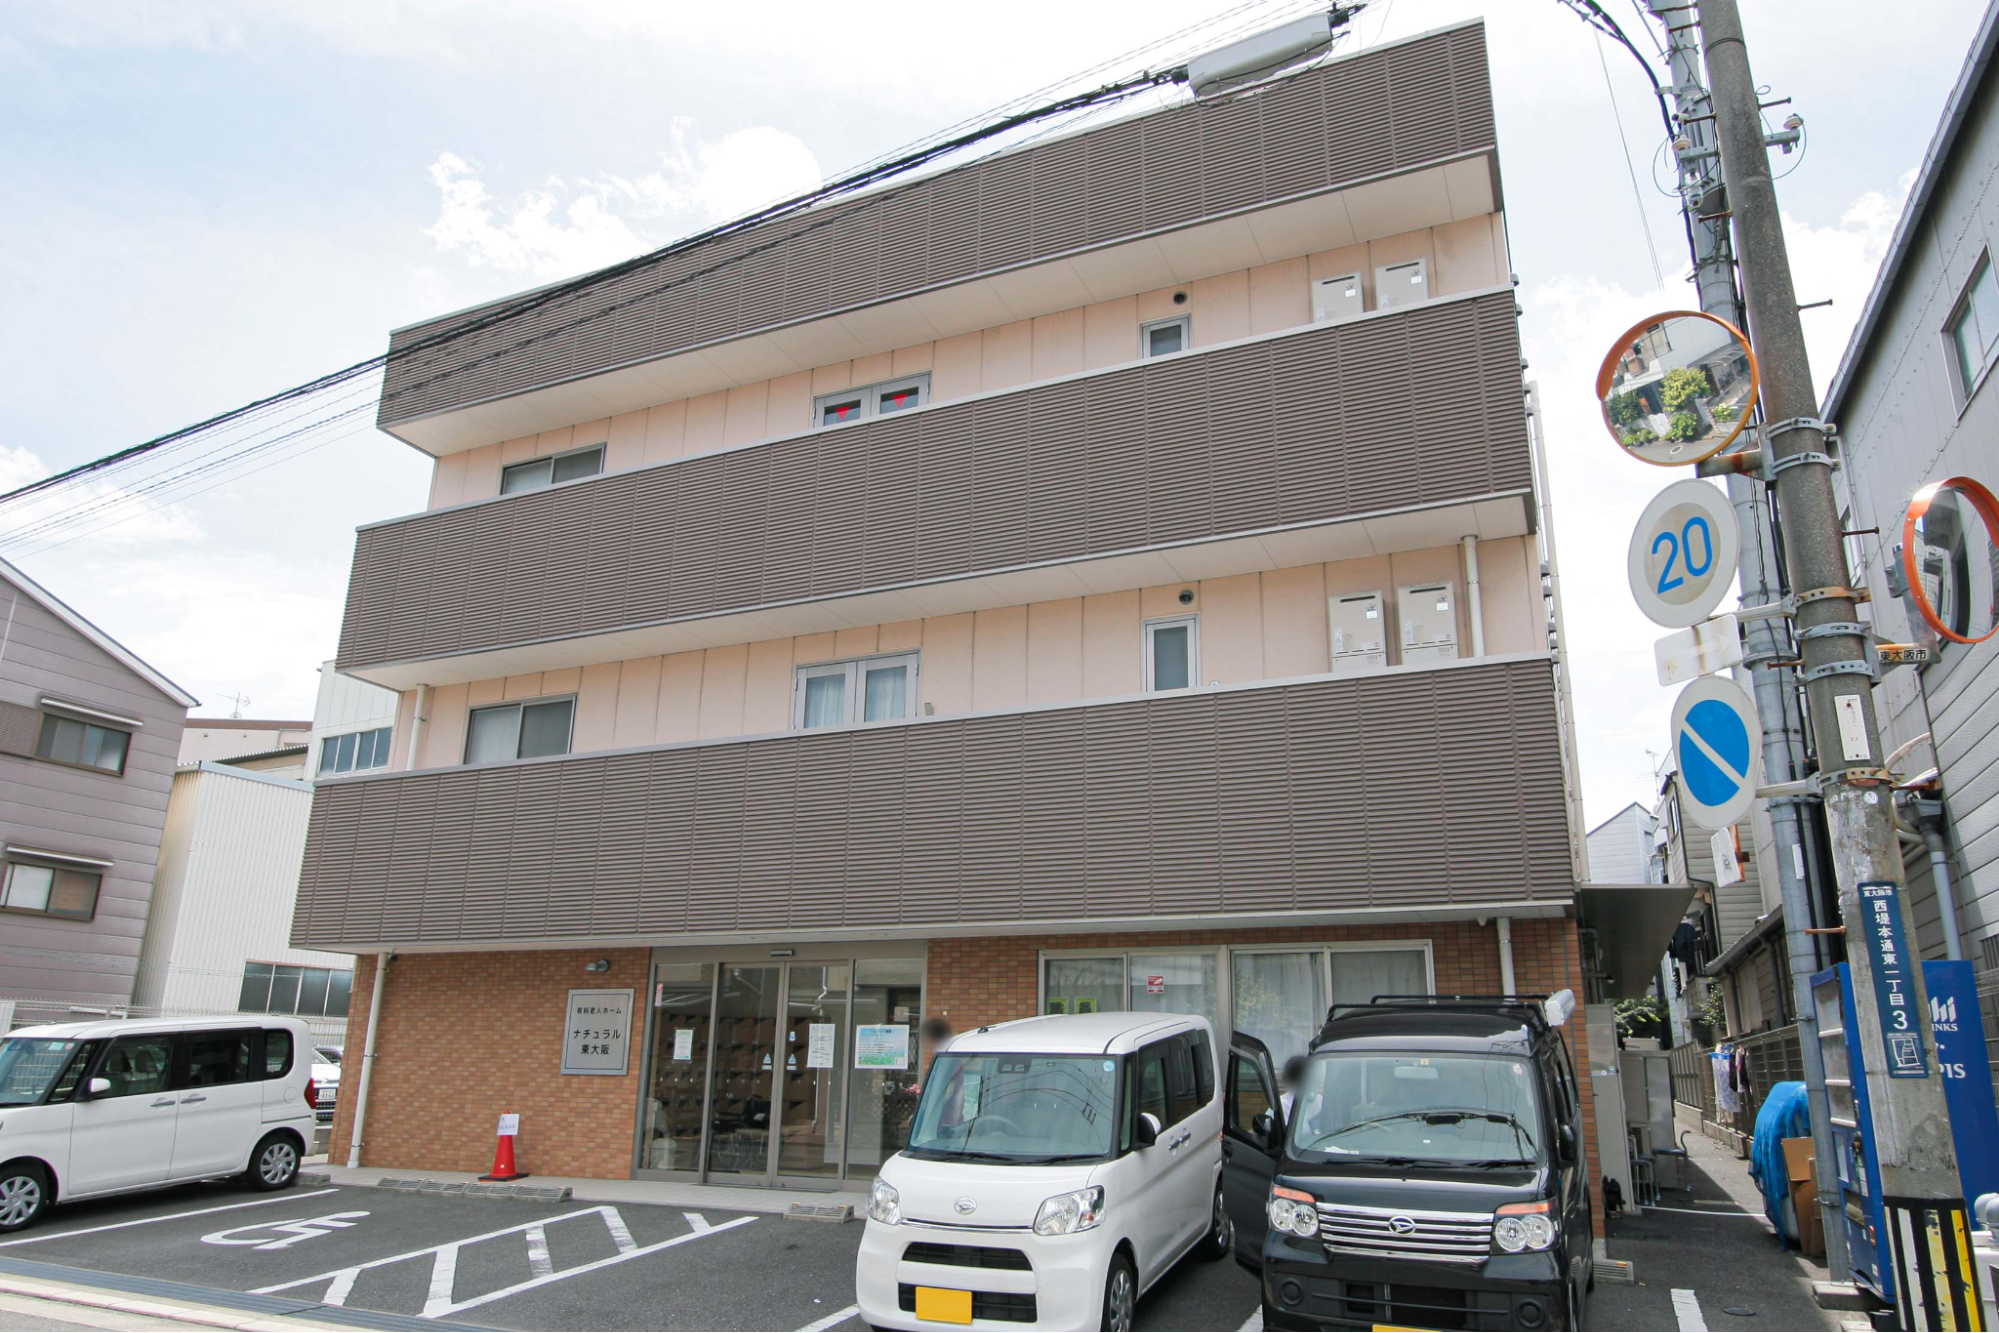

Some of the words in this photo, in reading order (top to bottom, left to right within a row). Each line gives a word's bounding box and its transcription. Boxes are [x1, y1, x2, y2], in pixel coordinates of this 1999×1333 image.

[1651, 516, 1713, 595] 20
[1879, 649, 1927, 661] 東大阪市
[1863, 889, 1893, 897] 東大阪市
[577, 1007, 622, 1015] 有料老人ホーム
[1928, 996, 1957, 1023] hi
[573, 1029, 621, 1040] ナチュラル
[581, 1044, 610, 1055] 東大阪
